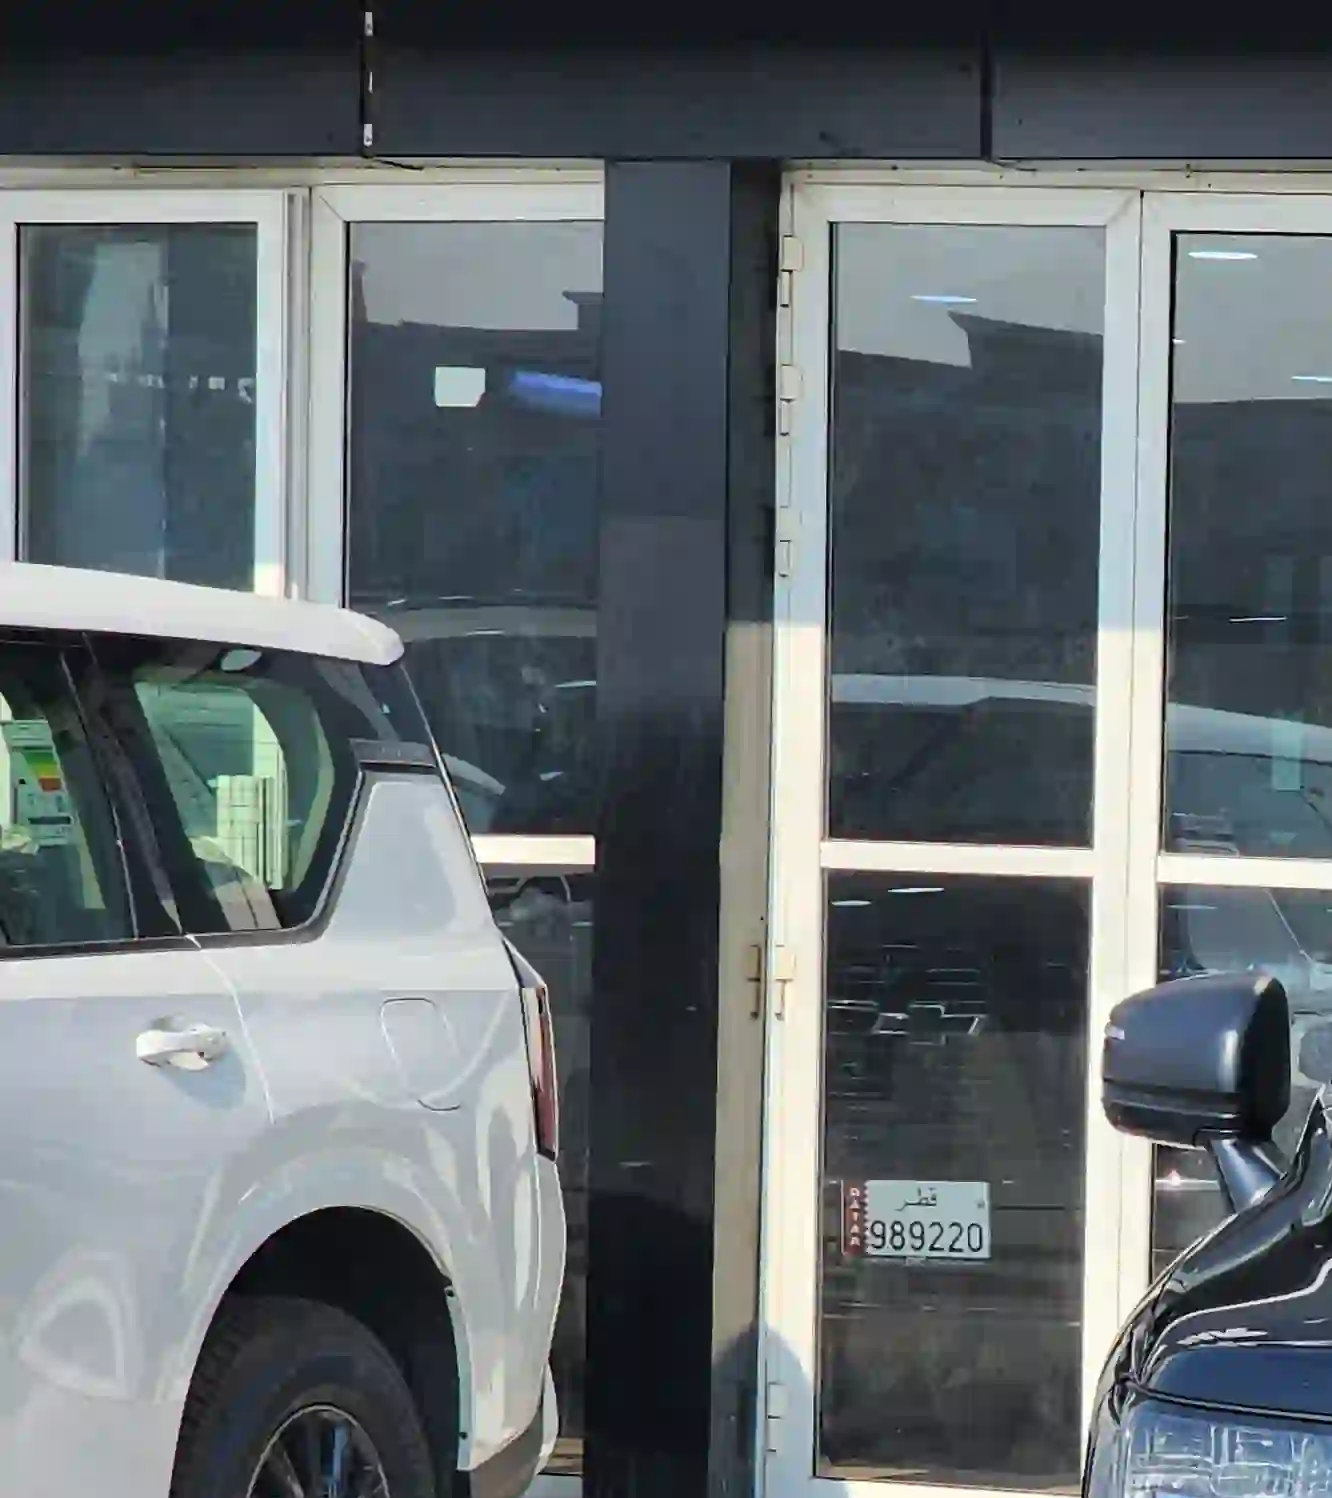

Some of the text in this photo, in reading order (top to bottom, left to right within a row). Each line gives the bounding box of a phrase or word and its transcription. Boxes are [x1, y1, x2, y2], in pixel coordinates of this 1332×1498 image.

[894, 1187, 938, 1212] قطر
[850, 1187, 861, 1246] QATAR
[869, 1220, 984, 1253] 989220
